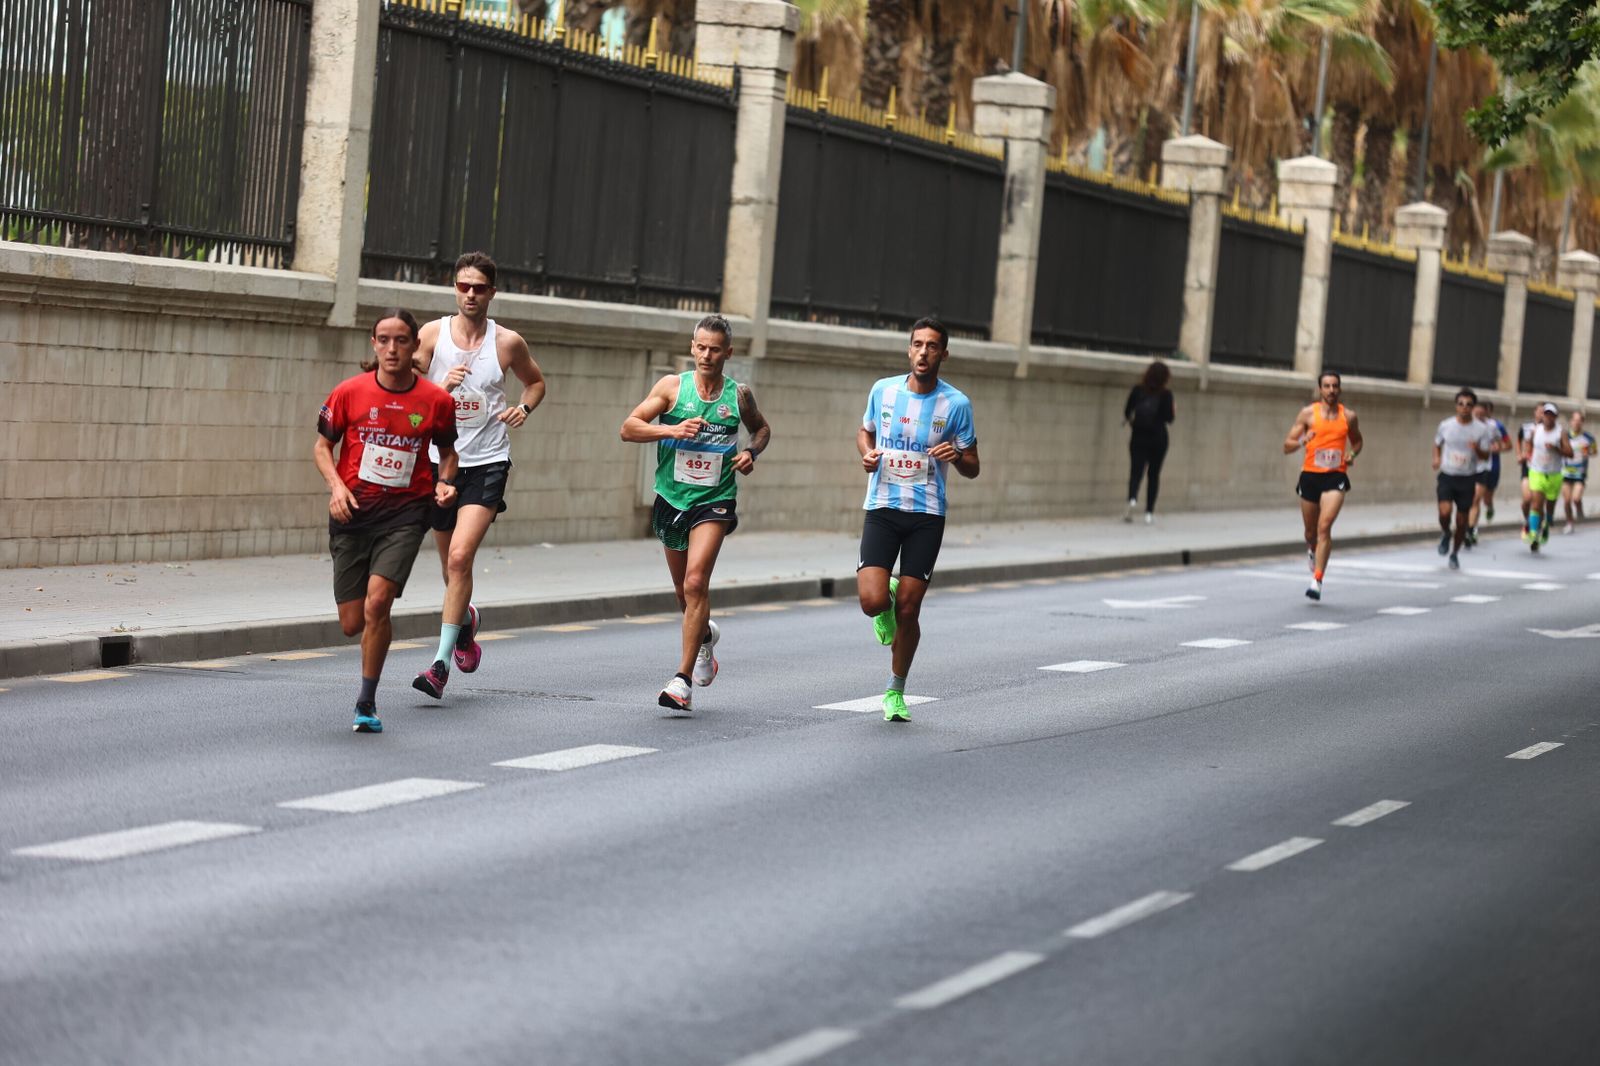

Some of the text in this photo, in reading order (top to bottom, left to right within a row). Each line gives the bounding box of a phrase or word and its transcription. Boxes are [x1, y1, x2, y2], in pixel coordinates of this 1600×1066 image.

[454, 401, 480, 411] 255
[375, 456, 403, 470] 420
[686, 459, 712, 470] 497
[889, 459, 922, 469] 1184
